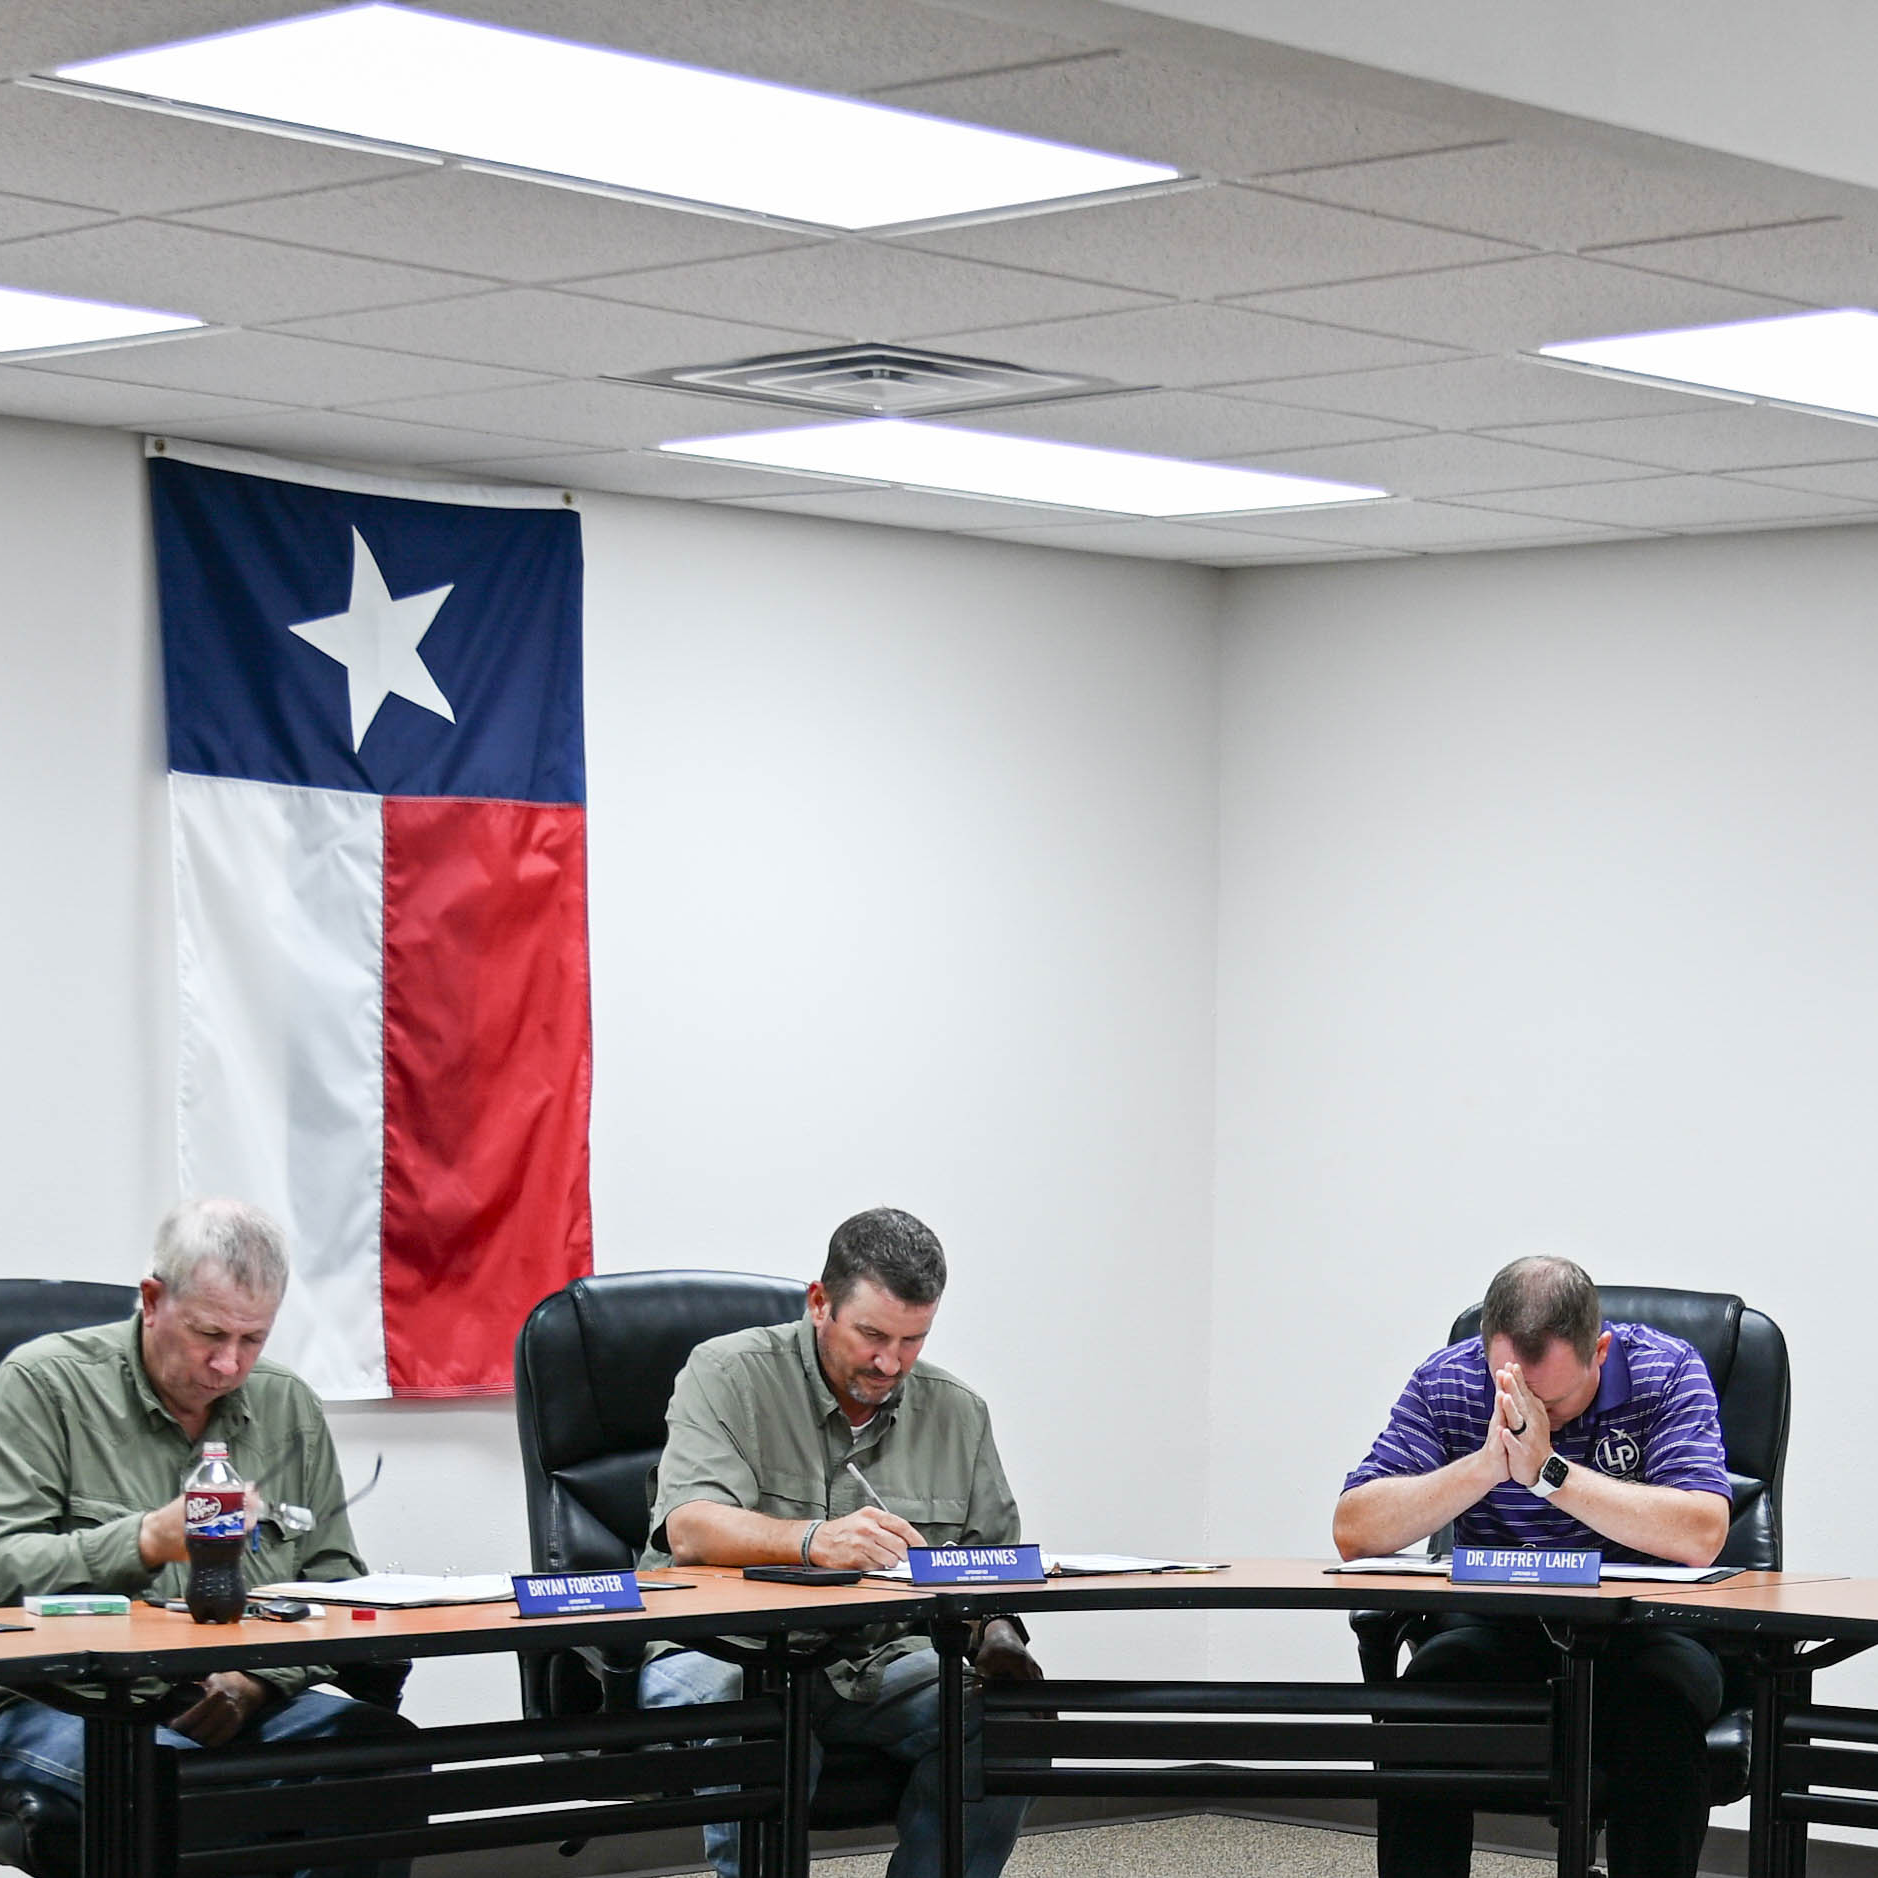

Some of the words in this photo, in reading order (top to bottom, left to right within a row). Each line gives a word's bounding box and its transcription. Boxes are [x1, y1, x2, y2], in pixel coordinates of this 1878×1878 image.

[931, 1550, 969, 1567] JACOB
[970, 1549, 1018, 1566] HAYNES
[1466, 1551, 1487, 1566] DR.
[1490, 1552, 1543, 1568] JEFFREY
[1545, 1552, 1587, 1568] LAHEY
[527, 1578, 568, 1597] BRYAN
[567, 1575, 624, 1595] FORESTER
